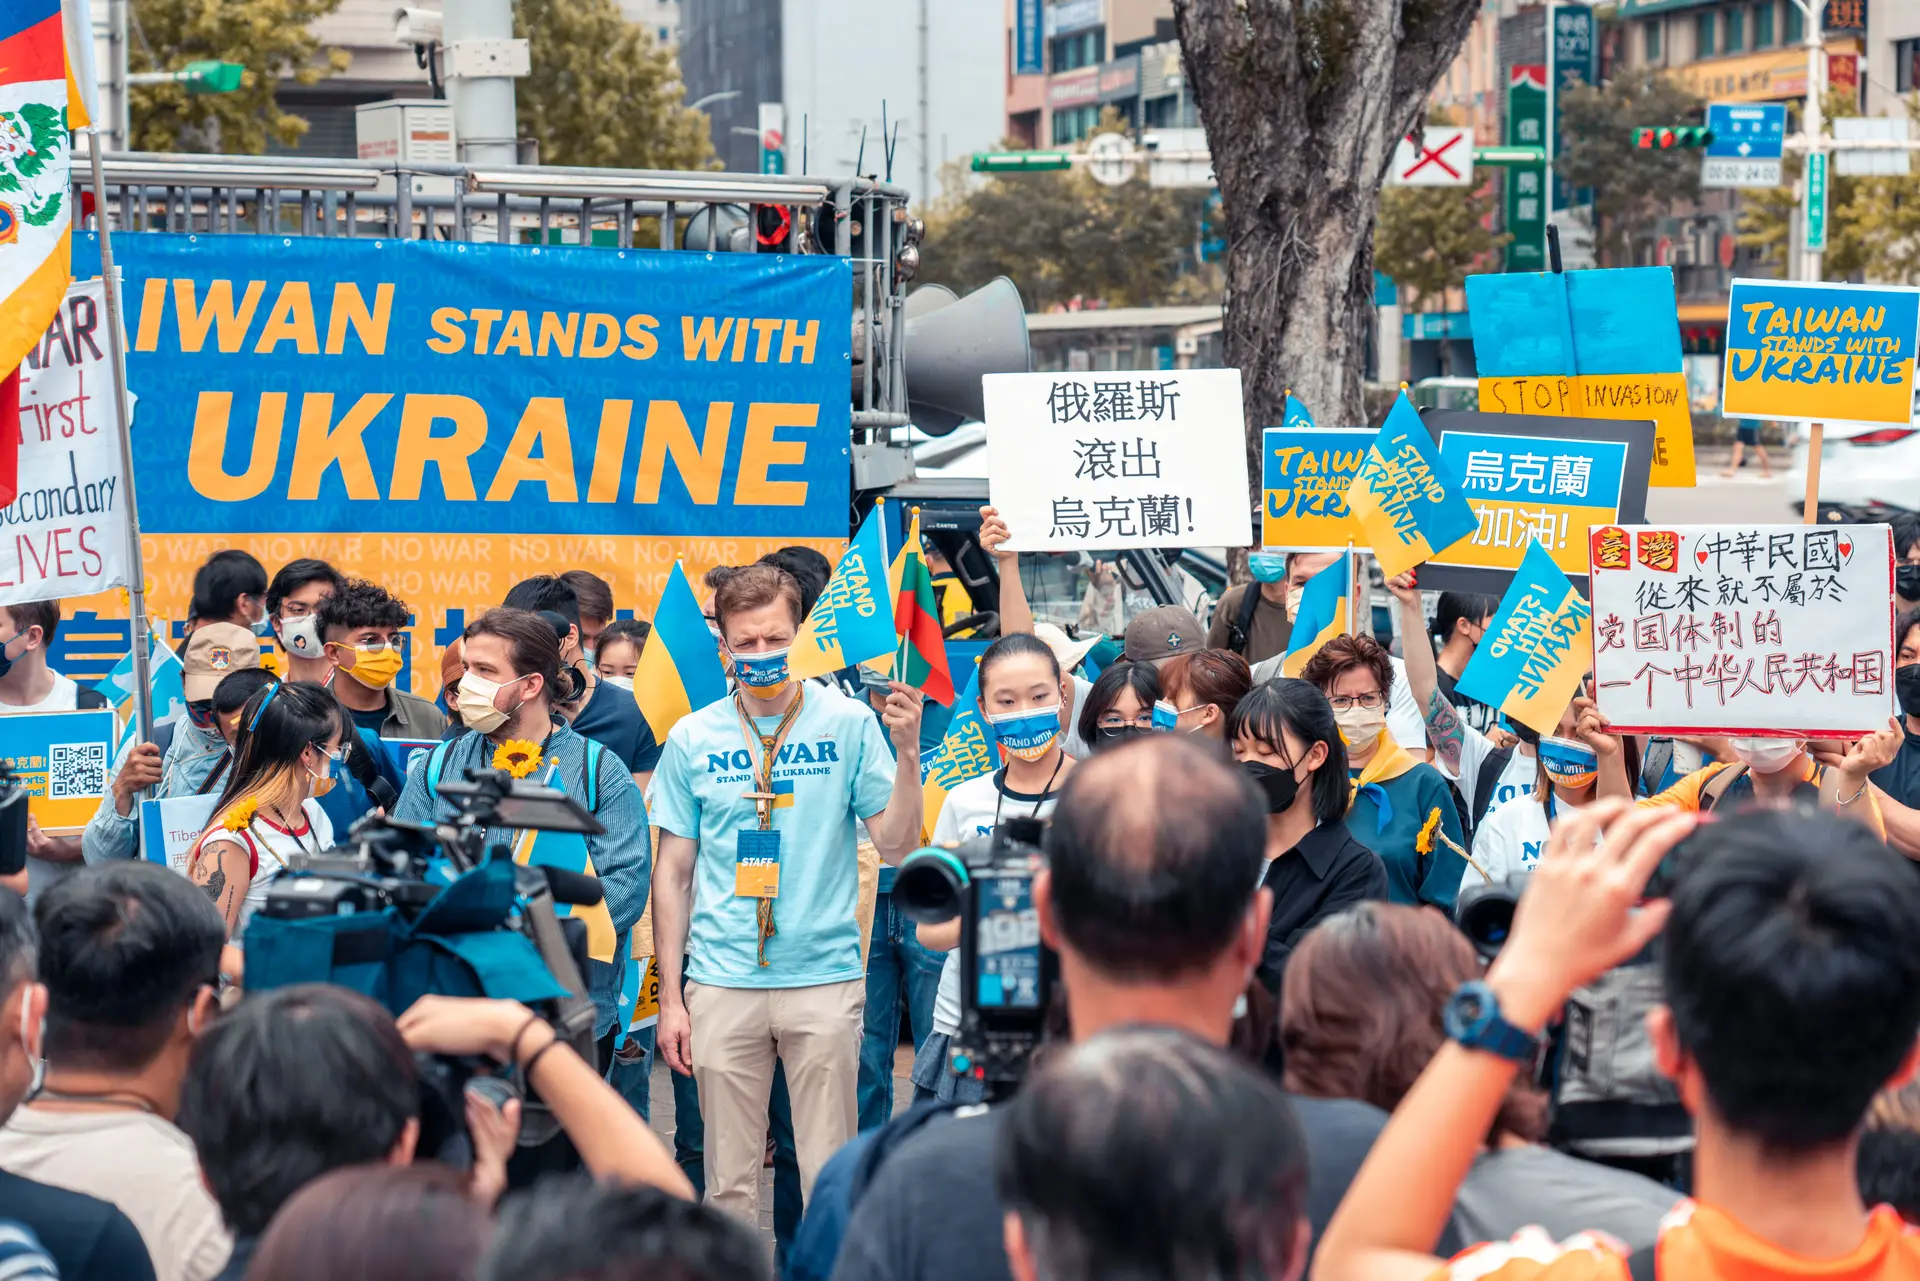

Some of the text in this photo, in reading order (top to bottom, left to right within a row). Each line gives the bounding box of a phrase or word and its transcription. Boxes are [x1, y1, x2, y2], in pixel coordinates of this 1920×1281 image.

[26, 296, 104, 370] AR
[124, 277, 820, 363] IWAN STANDS WITH
[1741, 301, 1887, 335] TAIWAN
[1761, 335, 1901, 354] STANDS WITH
[1731, 349, 1907, 386] UKRAINE
[1046, 379, 1181, 425] 俄羅斯
[1493, 379, 1680, 415] STOP INVASION
[187, 391, 820, 507] UKRAINE
[1073, 436, 1162, 481] 滾出
[1274, 445, 1365, 477] TAIW
[1293, 475, 1353, 491] STAND
[1398, 444, 1446, 504] STAND
[1461, 449, 1594, 498] 烏克蘭
[1049, 493, 1195, 539] 烏克蘭!
[1359, 454, 1419, 546] KRAINE
[1470, 504, 1570, 551] 加油!
[1598, 527, 1676, 571] 臺灣
[249, 538, 293, 563] NO
[300, 538, 363, 562] WAR
[380, 538, 423, 563] NO
[430, 538, 492, 563] WAR
[509, 539, 550, 564] NO
[557, 539, 617, 564] WAR
[633, 540, 673, 564] NO
[681, 540, 740, 565] WAR
[430, 570, 492, 597] WAR
[844, 553, 877, 617] STAND
[1634, 572, 1848, 616] 從來就不屬於
[1597, 608, 1783, 653] 党国体制的
[1599, 650, 1885, 710] 一个中华人民共和国
[961, 720, 993, 773] STAN
[1003, 729, 1053, 748] STAND WITH
[707, 748, 753, 774] NO
[716, 774, 751, 784] STAND
[782, 766, 831, 777] UKRAINE
[1563, 763, 1586, 775] WITH
[741, 857, 774, 868] STAFF
